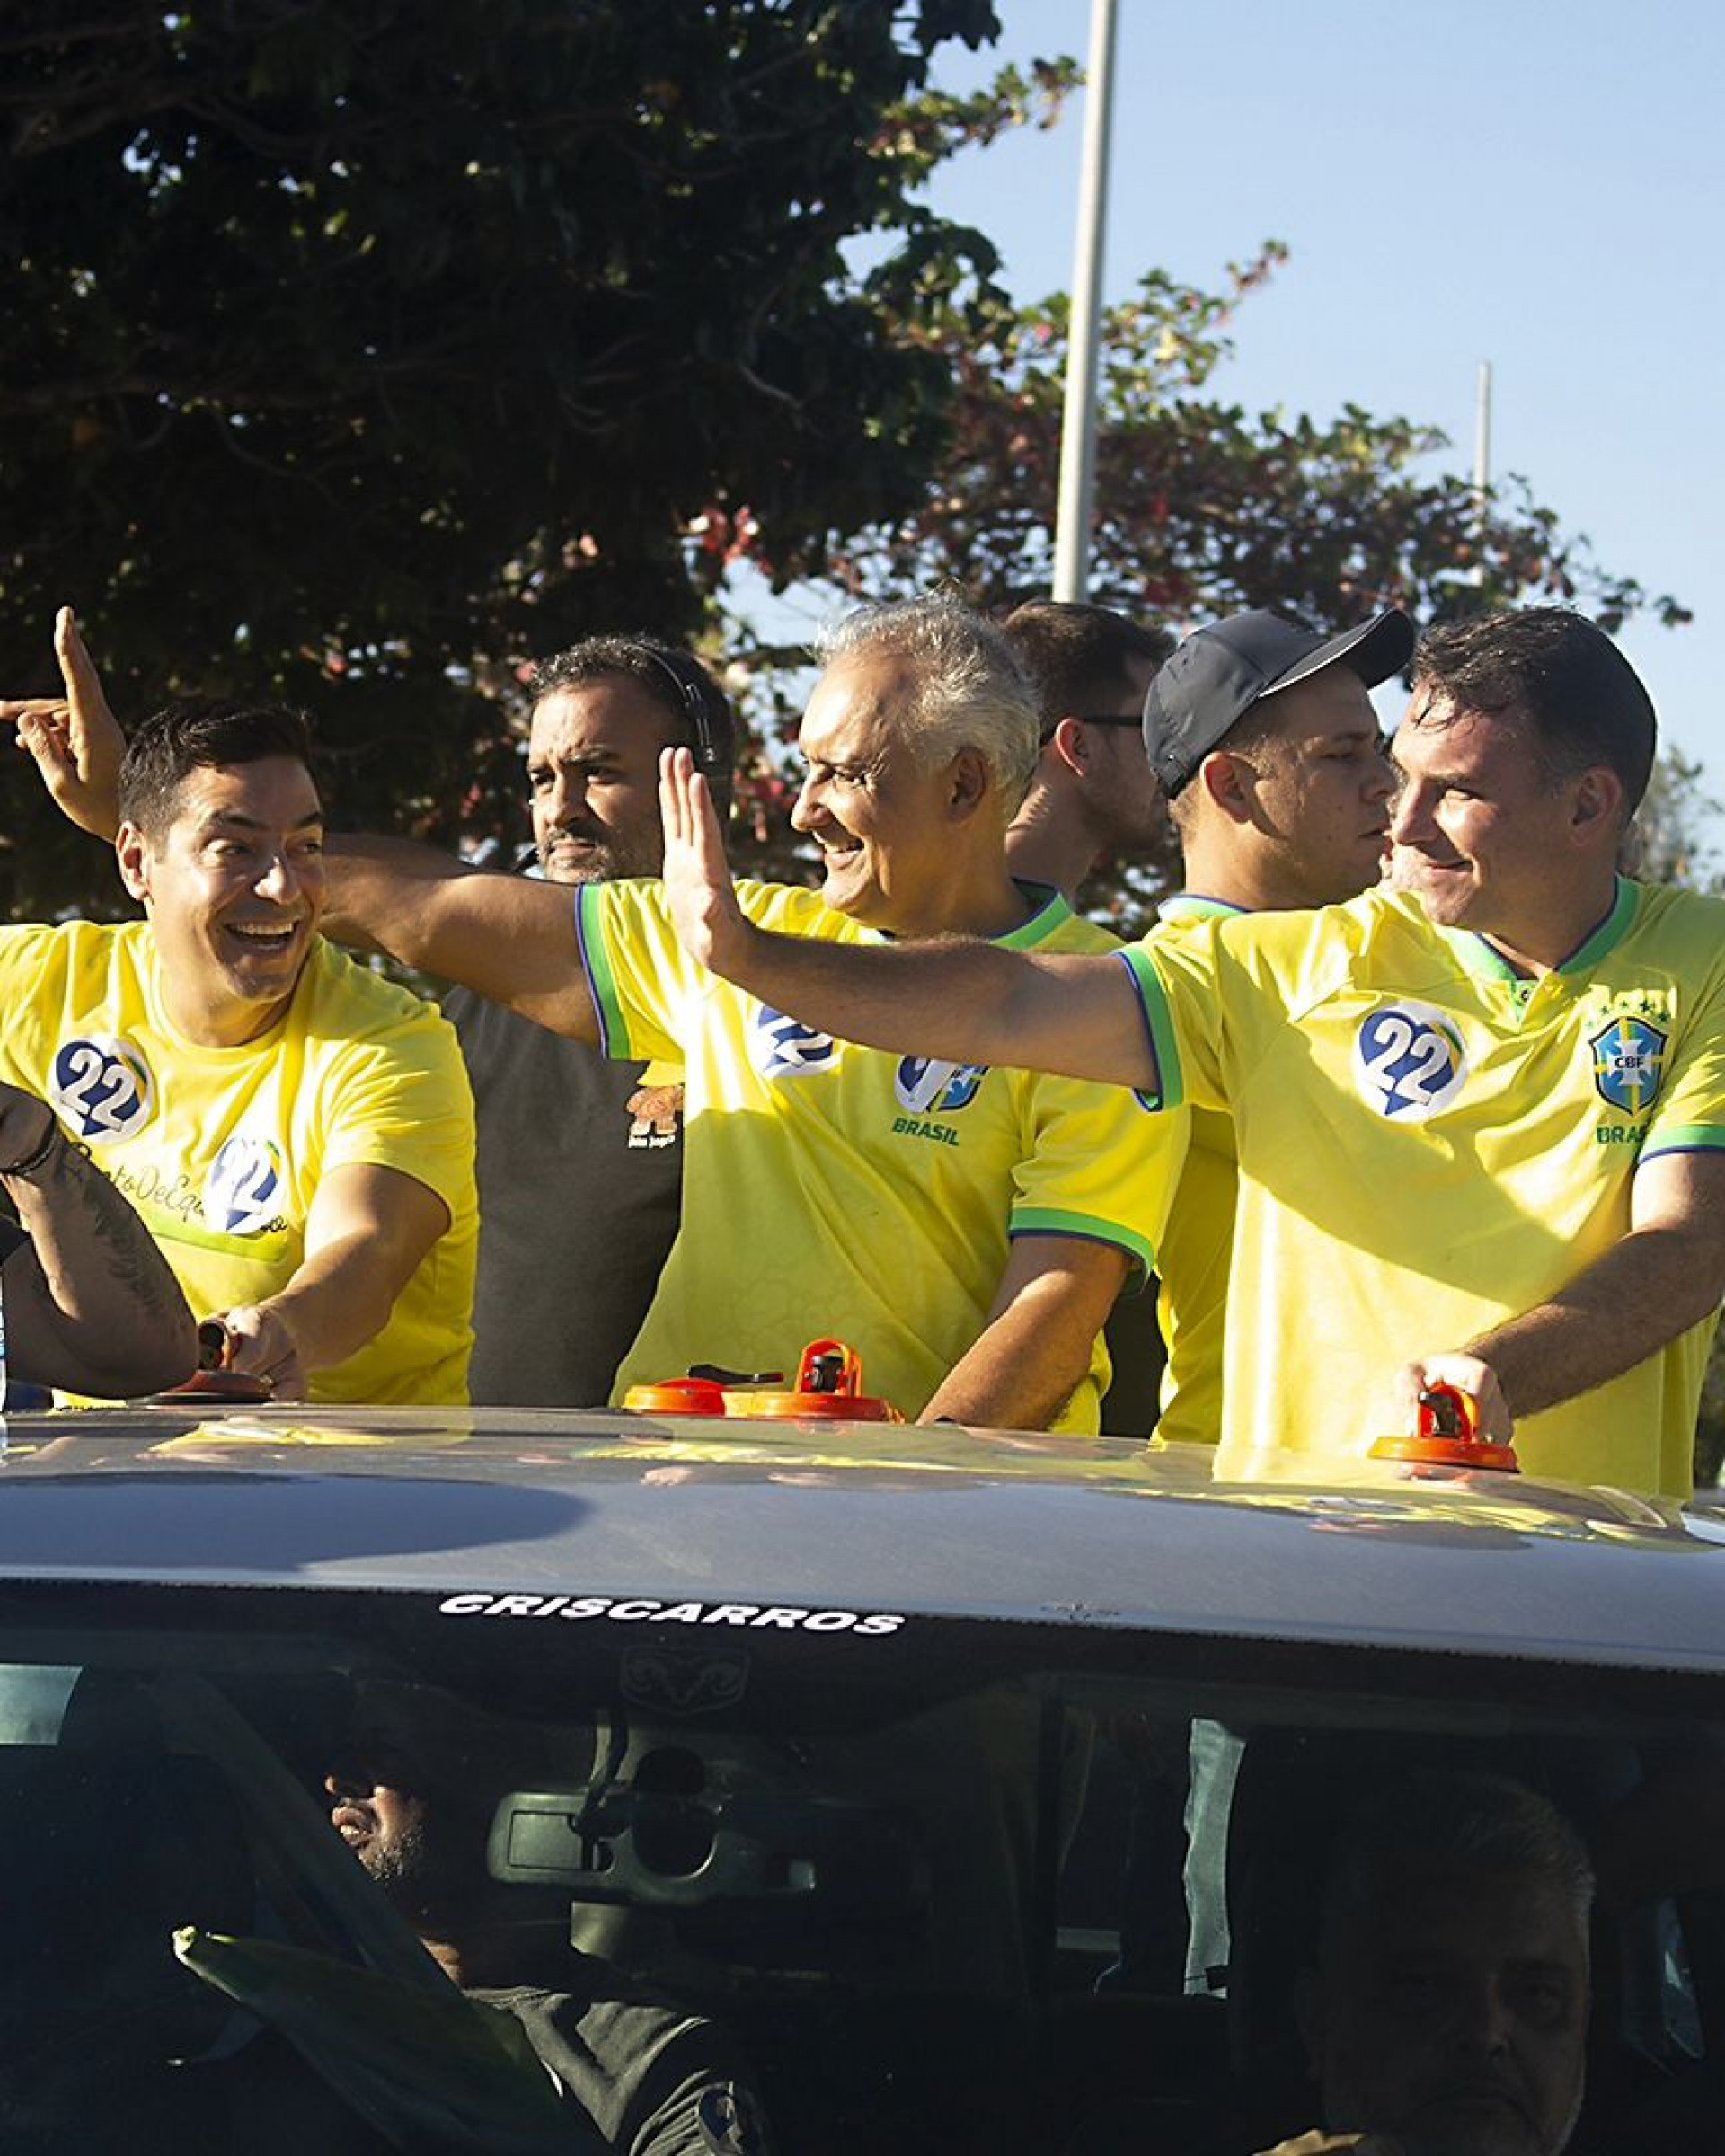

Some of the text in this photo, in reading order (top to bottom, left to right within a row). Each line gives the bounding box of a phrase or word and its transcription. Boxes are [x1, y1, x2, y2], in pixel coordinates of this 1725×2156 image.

[1363, 1017, 1448, 1106] 22
[1615, 1056, 1644, 1069] CBF
[59, 1048, 134, 1132] 22
[892, 1118, 959, 1146] BRASIL
[440, 1595, 906, 1635] CRISCARROS
